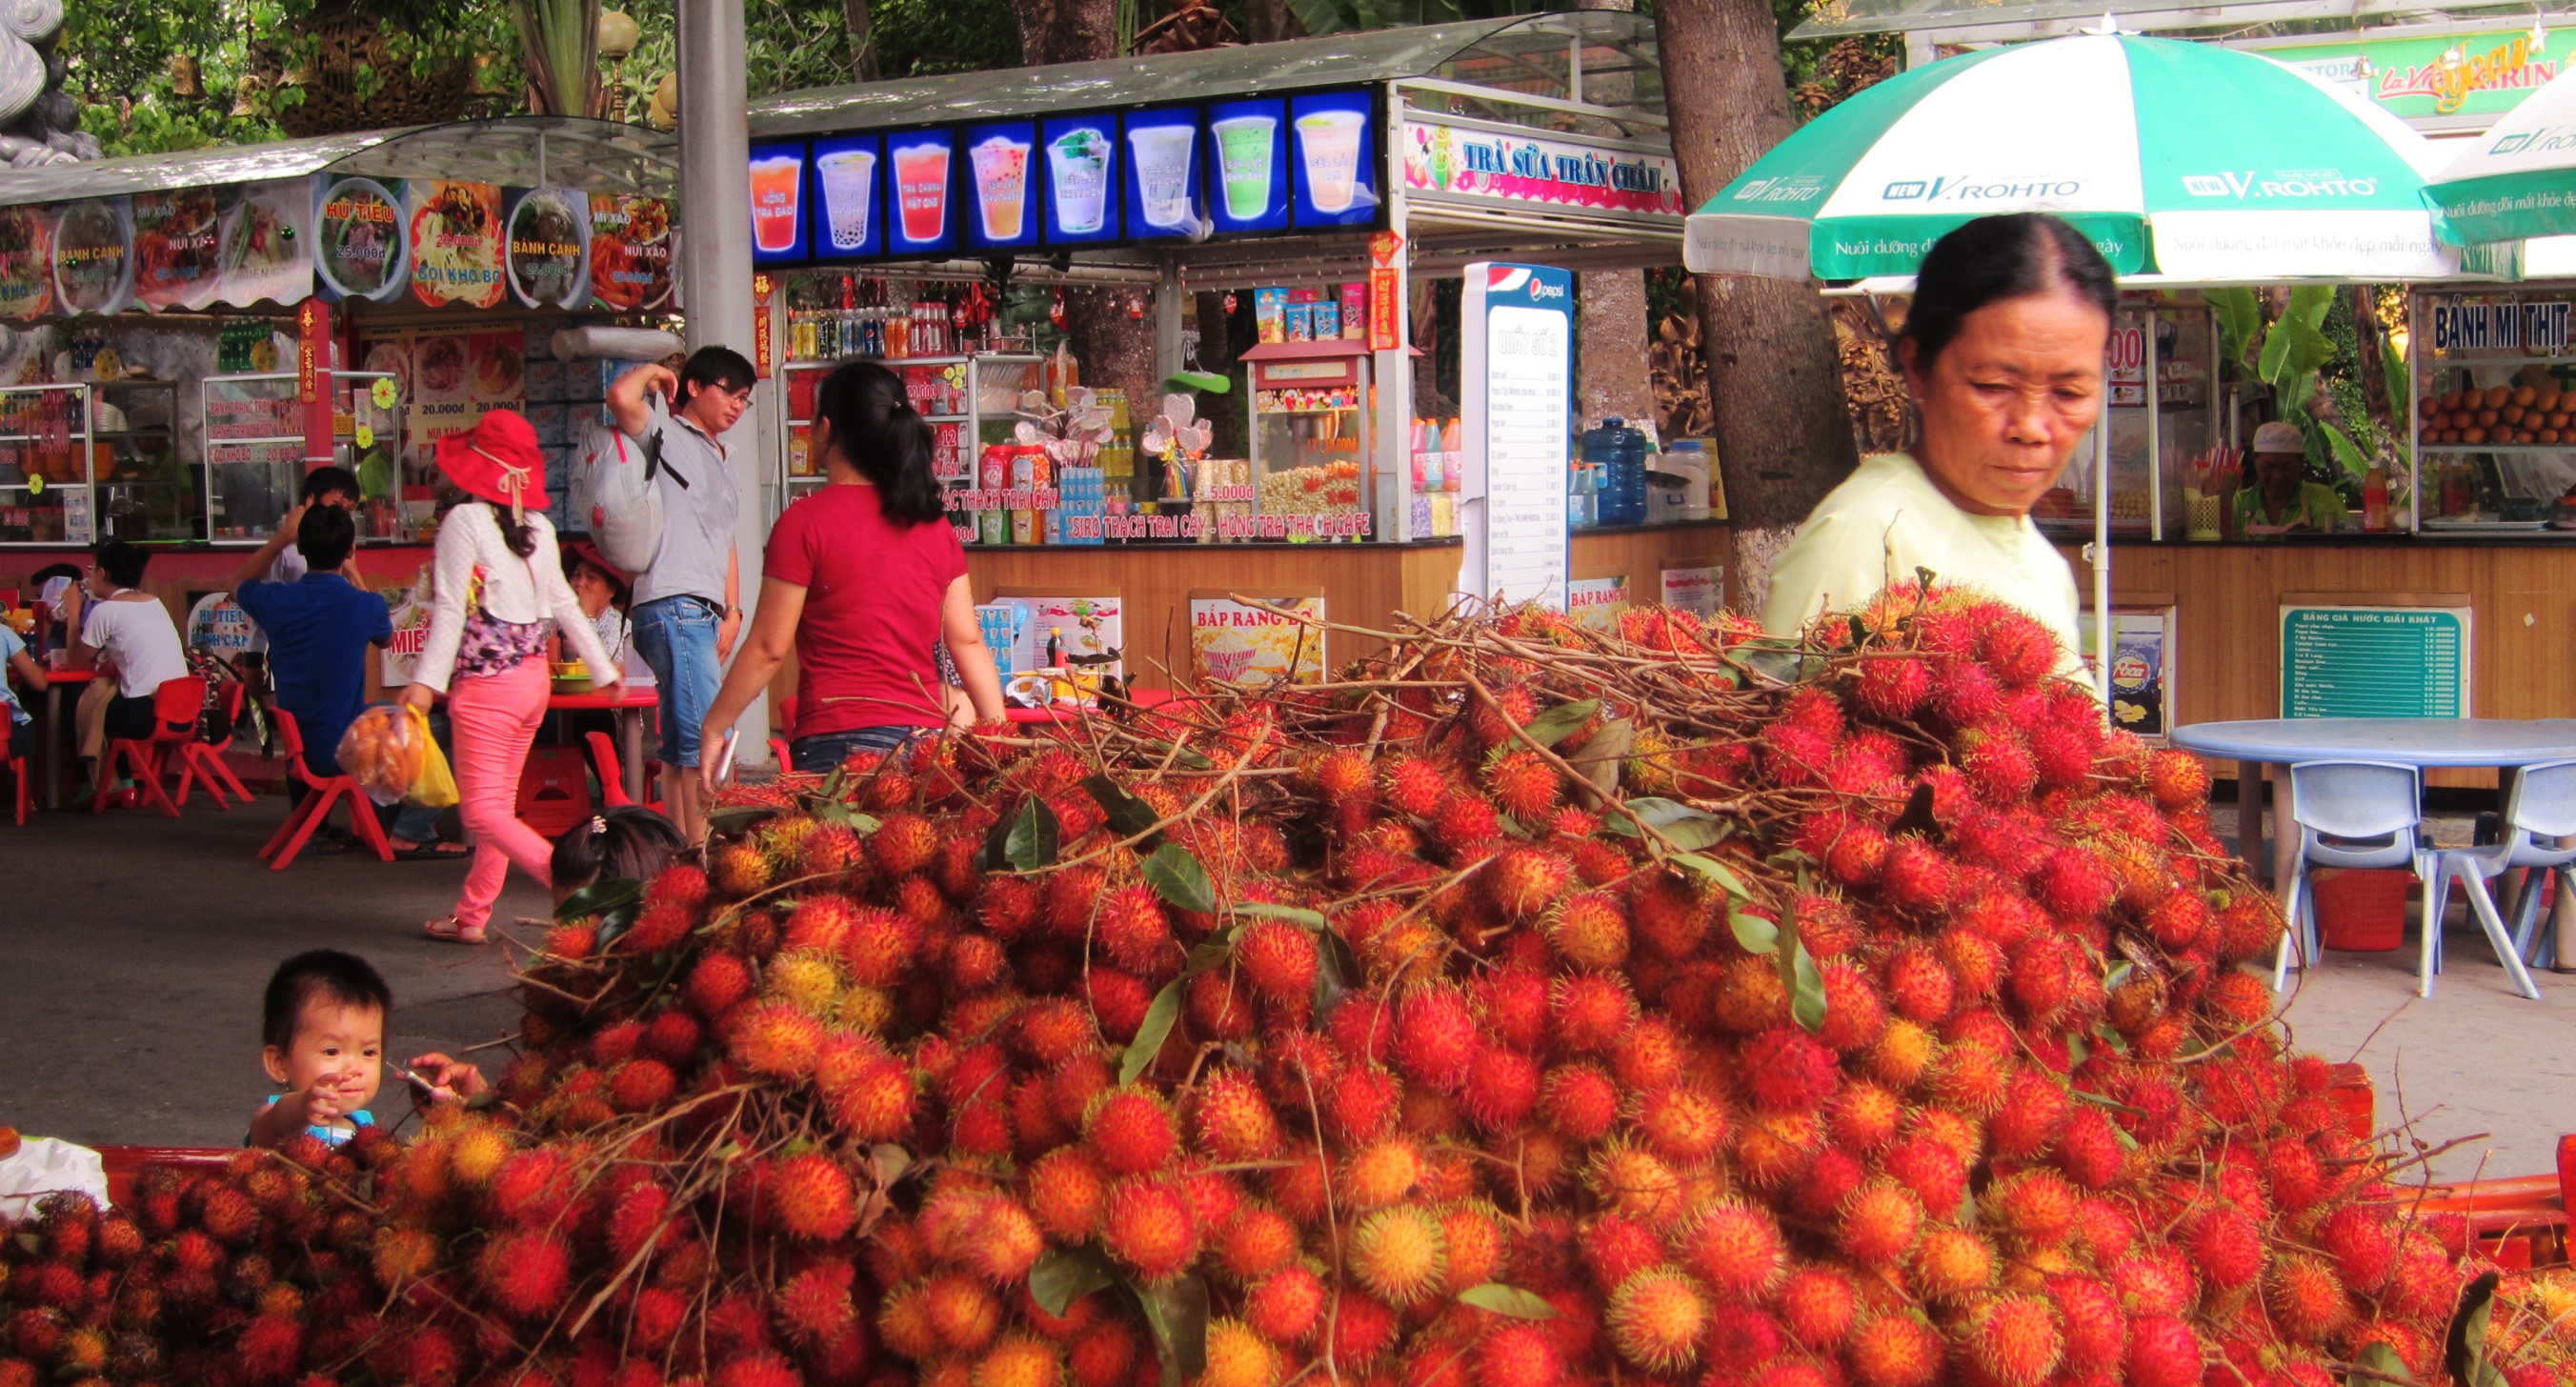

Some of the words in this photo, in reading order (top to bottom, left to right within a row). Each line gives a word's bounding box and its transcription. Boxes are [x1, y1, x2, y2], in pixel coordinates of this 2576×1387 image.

[1463, 138, 1507, 174] TRÀ
[1513, 144, 1552, 179] SỮA
[1556, 151, 1609, 187] TRÂN
[1612, 159, 1660, 194] CHÂU
[1890, 182, 1922, 197] NEW
[2189, 180, 2222, 191] NEW
[549, 243, 581, 257] CANH
[1836, 239, 1869, 255] Nuôi
[1875, 239, 1918, 258] dưỡng
[1541, 284, 1565, 298] pepsi
[2434, 293, 2490, 350] BÁNH
[2494, 291, 2520, 348] MÌ
[2524, 301, 2570, 358] THỊT
[1550, 333, 1559, 356] 2
[422, 405, 465, 415] 20.000đ
[1233, 611, 1283, 627] RANG
